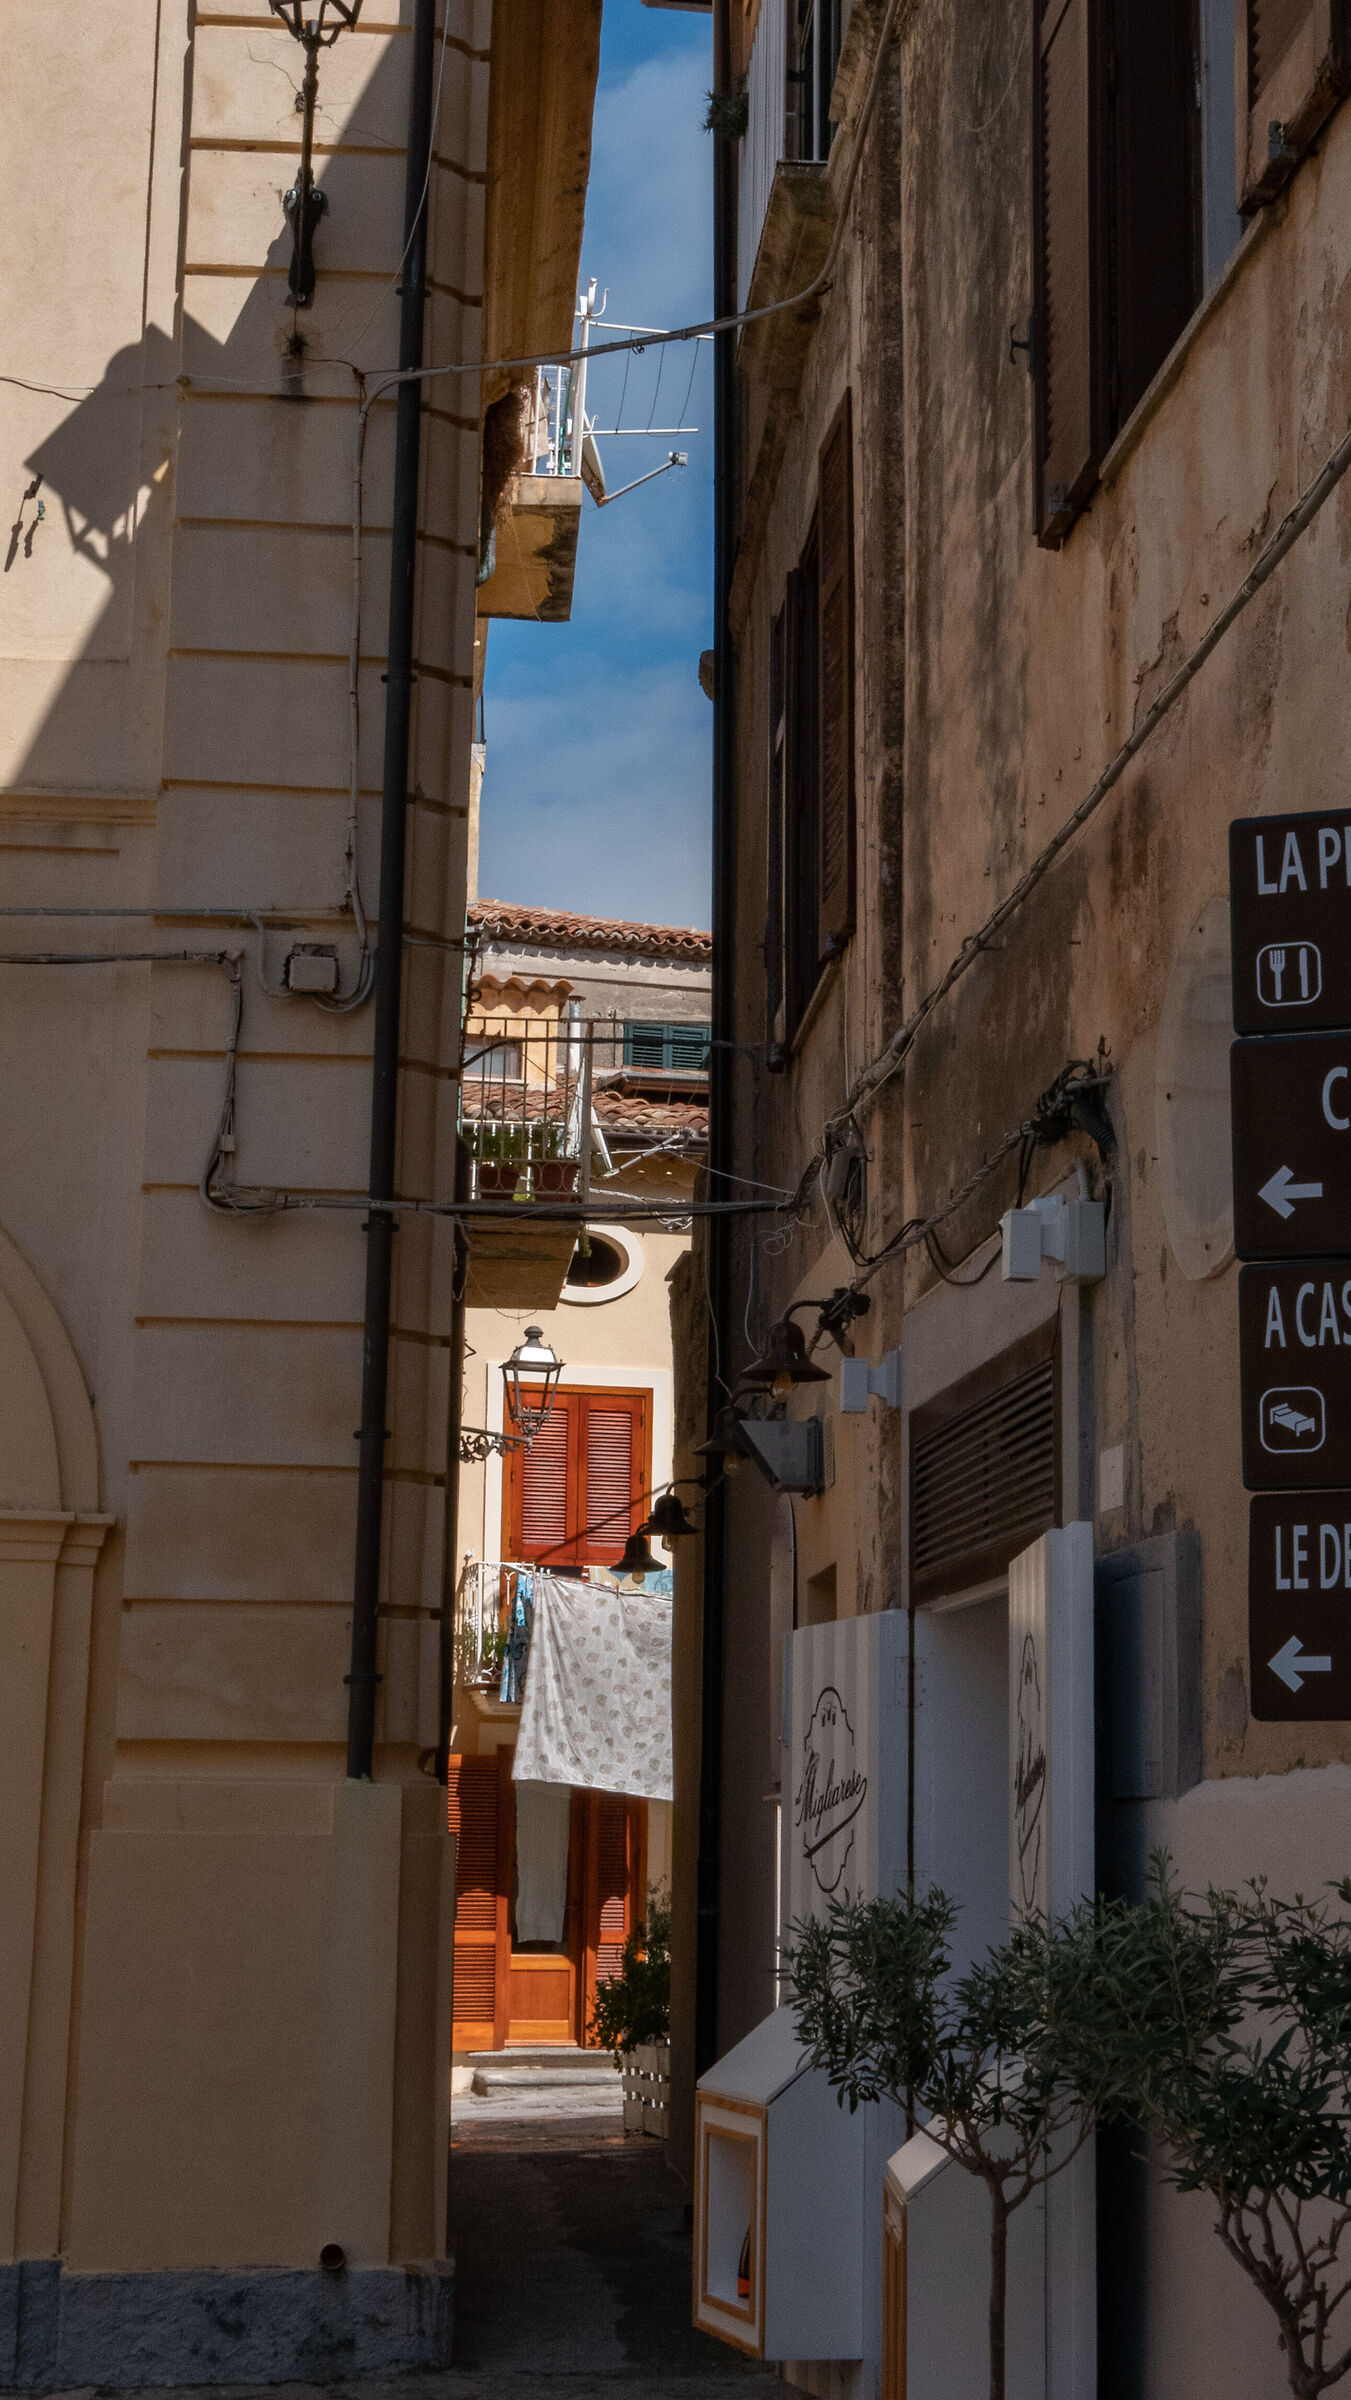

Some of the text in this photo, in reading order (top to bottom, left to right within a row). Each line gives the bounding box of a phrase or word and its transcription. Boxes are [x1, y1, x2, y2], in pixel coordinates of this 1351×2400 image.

[1255, 831, 1308, 896] LA
[1264, 1285, 1287, 1349] A
[1275, 1524, 1309, 1591] LE
